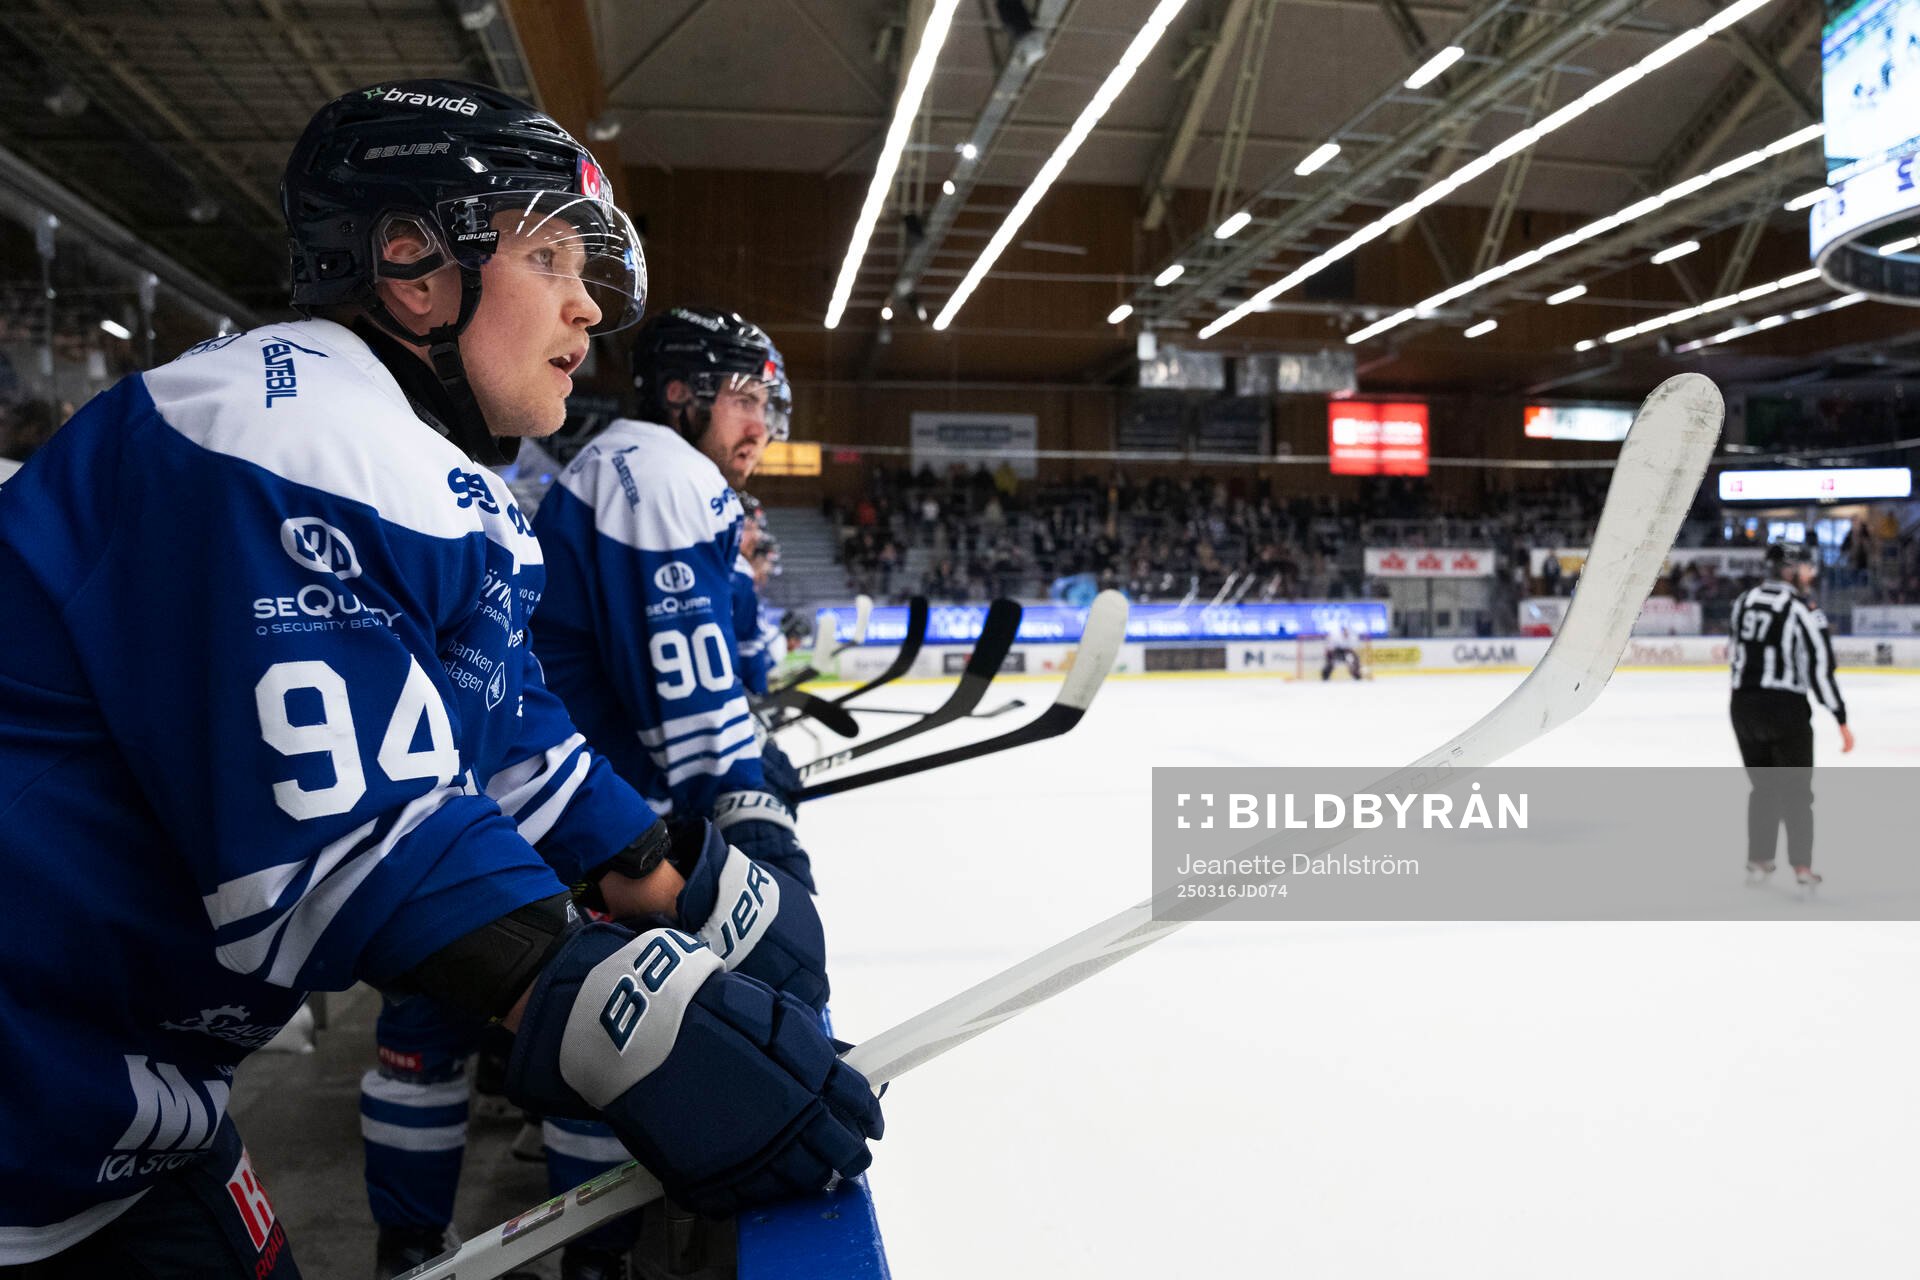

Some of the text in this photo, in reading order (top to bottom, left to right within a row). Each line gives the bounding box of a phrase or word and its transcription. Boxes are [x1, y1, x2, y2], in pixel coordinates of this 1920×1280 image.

[383, 87, 478, 117] bravida
[271, 620, 346, 634] SECURITY
[1740, 609, 1773, 642] 97
[443, 660, 484, 692] slagen
[648, 622, 735, 701] 90
[254, 653, 461, 822] 94
[96, 1154, 137, 1184] ICA
